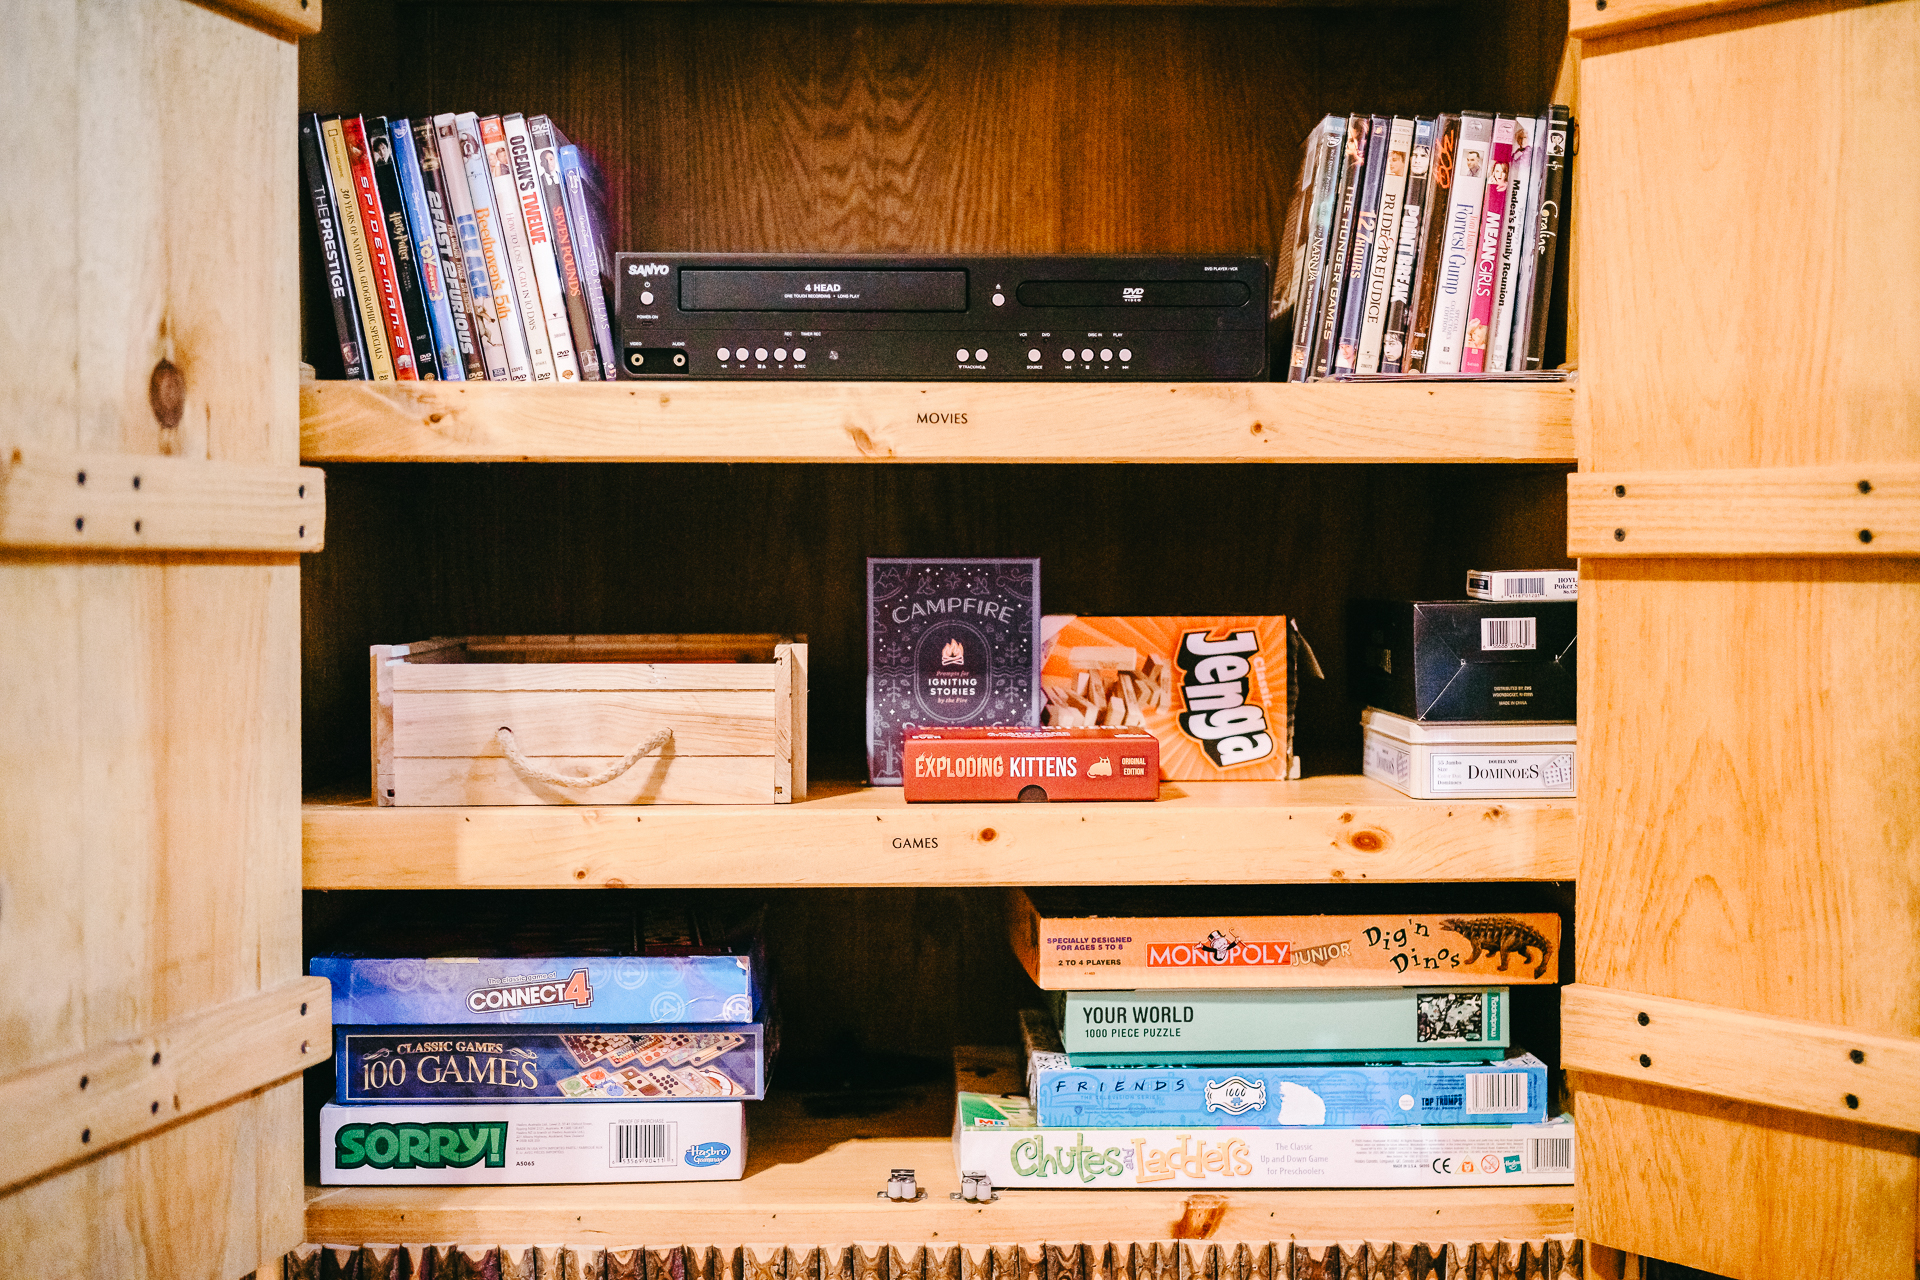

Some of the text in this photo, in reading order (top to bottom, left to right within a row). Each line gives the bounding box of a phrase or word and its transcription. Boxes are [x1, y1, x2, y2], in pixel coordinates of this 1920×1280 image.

[531, 124, 549, 132] DVD
[340, 188, 351, 200] 30
[509, 135, 547, 245] OCEAN'S TWELVE
[344, 200, 356, 225] YEARS
[388, 210, 406, 237] Harry
[1380, 193, 1397, 236] PRIDE
[350, 225, 358, 236] OF
[510, 233, 518, 244] TO
[1538, 200, 1558, 255] Coraline
[314, 185, 345, 299] THE PRESTIGE
[353, 236, 366, 273] NATIONAL
[393, 232, 410, 262] Potter
[513, 244, 522, 265] LOSE
[553, 206, 581, 297] SEVEN POUNDS
[1350, 210, 1377, 279] 127 HOURS
[1391, 204, 1420, 304] POINT BREAK
[1442, 203, 1474, 295] Forrest Gump
[1476, 211, 1501, 297] MEAN GIRLS
[1499, 179, 1521, 307] Madea's Family Reunion
[419, 236, 437, 267] TOY
[429, 291, 444, 301] 3
[457, 213, 493, 299] ICE AGE
[475, 207, 511, 319] Beethoven's 5th
[1308, 236, 1324, 281] NARNIA
[1324, 186, 1355, 340] THE HUNGER GAMES
[517, 271, 528, 289] GUY
[628, 263, 669, 277] SANYO
[522, 289, 531, 298] IN
[587, 251, 610, 330] SHORT FILMS
[804, 283, 841, 292] 4 HEAD
[1122, 287, 1145, 295] DVD
[1367, 246, 1388, 324] PREJUDICE
[360, 274, 375, 325] GEOGRAPHIC
[527, 310, 537, 331] DAYS
[369, 325, 384, 360] SPECIALS
[395, 336, 405, 348] 2
[917, 412, 968, 424] MOVIES
[892, 597, 1015, 624] CAMPFIRE
[928, 678, 978, 686] IGNITING
[930, 687, 976, 696] STORIES
[1253, 656, 1272, 708] Classic
[1185, 630, 1274, 768] Jenga
[915, 755, 1077, 778] EXPLODING KITTENS
[1123, 768, 1145, 776] EDITION
[892, 837, 939, 849] GAMES
[1149, 942, 1351, 967] MONOPOLY JUNIOR
[1389, 948, 1460, 974] Dinos
[469, 972, 589, 1010] CONNECT 4
[487, 971, 557, 985] The classic game of
[1083, 1006, 1194, 1024] YOUR WORLD
[1085, 1027, 1181, 1038] 1000 PIECE PUZZLE
[396, 1041, 503, 1055] CLASSIC GAMES
[362, 1055, 539, 1091] 100 GAMES
[1421, 1097, 1434, 1106] TOP
[1436, 1096, 1463, 1106] TRUMPS
[339, 1126, 502, 1165] SORRY!
[686, 1145, 728, 1158] Hasbro
[1010, 1133, 1124, 1183] Chutes
[1130, 1134, 1252, 1183] Ladders
[1289, 1142, 1313, 1150] Classic
[1260, 1155, 1270, 1163] Up
[1271, 1155, 1285, 1163] and
[1286, 1155, 1307, 1163] Down
[1267, 1167, 1325, 1175] for Preschoolers
